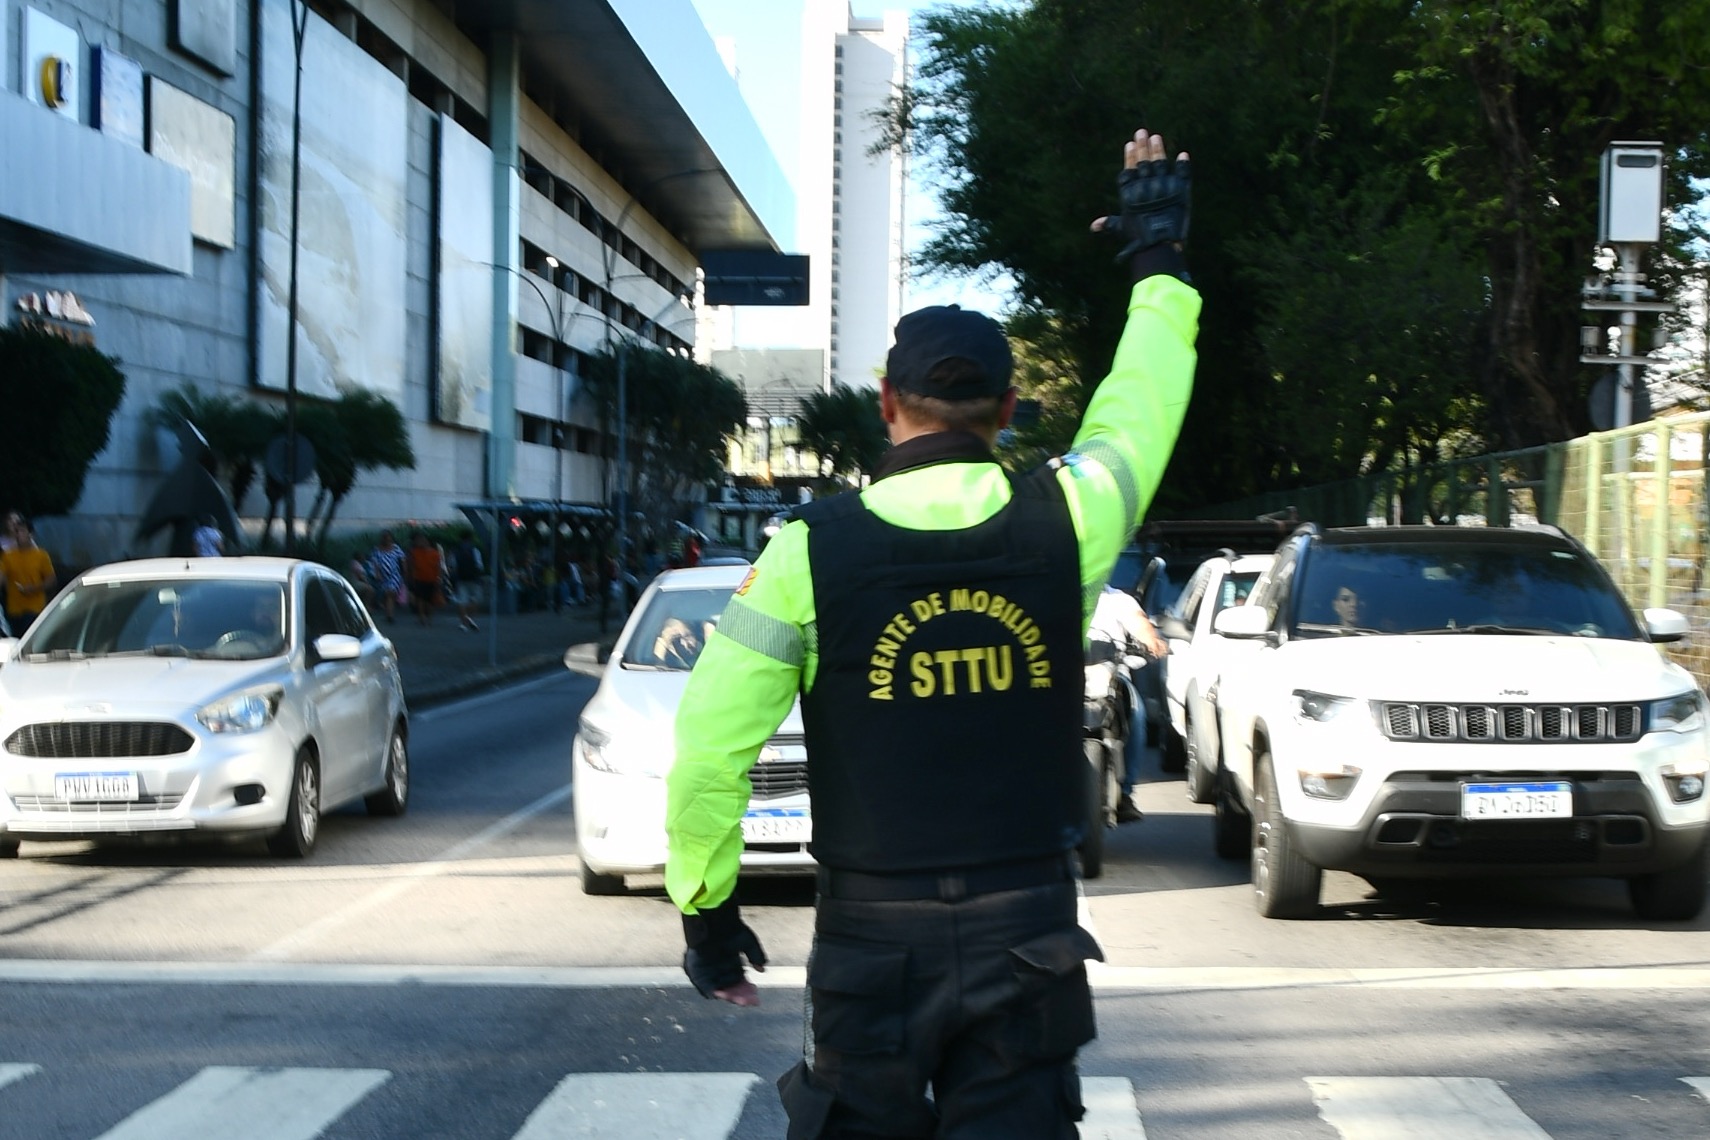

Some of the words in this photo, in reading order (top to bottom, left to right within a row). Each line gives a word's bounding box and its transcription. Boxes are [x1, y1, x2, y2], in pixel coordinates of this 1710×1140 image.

[868, 613, 917, 700] AGENTE
[910, 592, 946, 622] DE
[950, 588, 1052, 688] MOBILIDADE
[910, 645, 1013, 697] STTU
